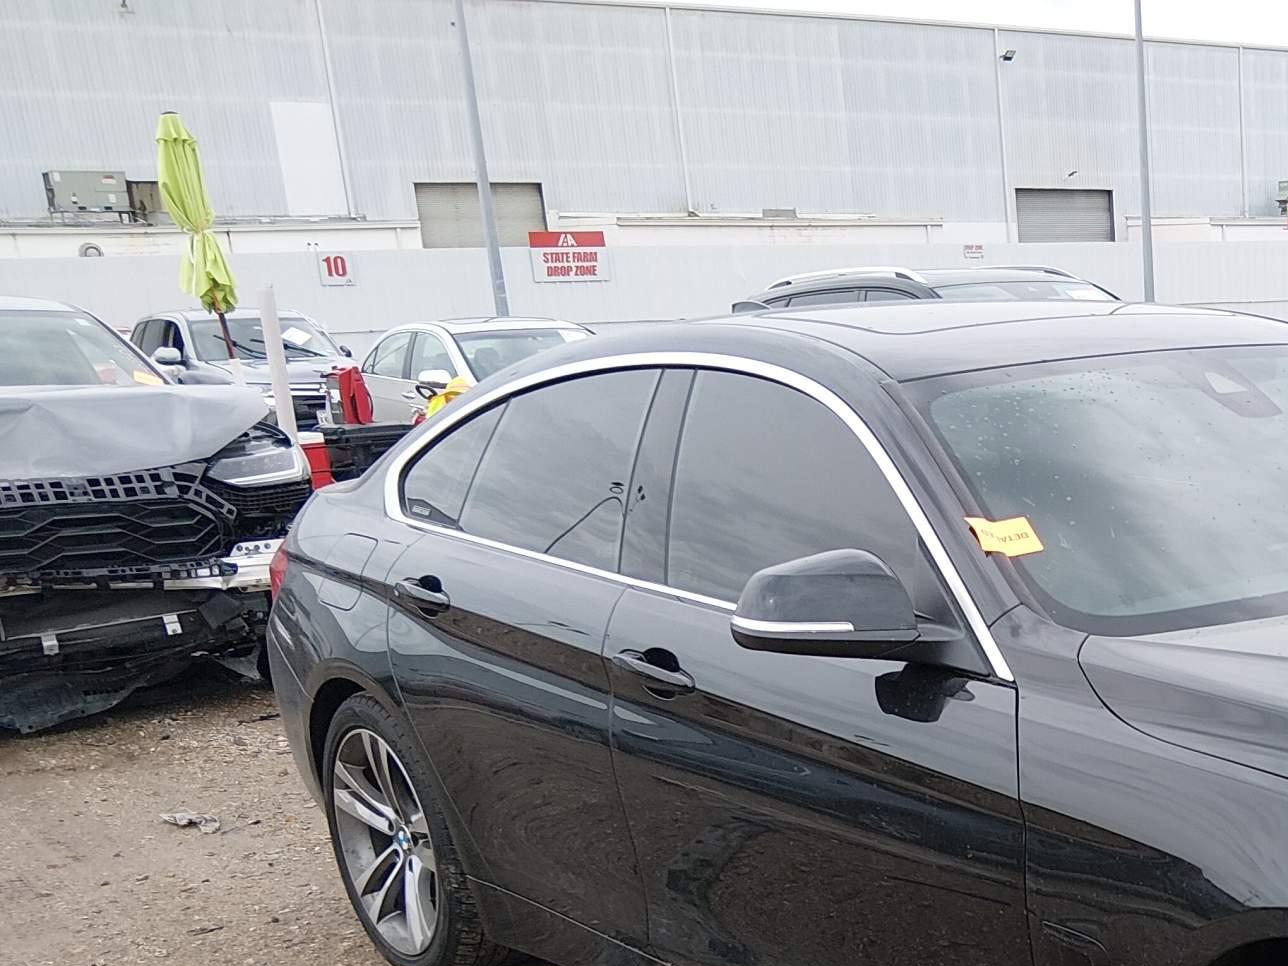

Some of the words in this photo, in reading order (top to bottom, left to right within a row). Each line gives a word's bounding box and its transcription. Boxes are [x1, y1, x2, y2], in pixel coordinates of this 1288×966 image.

[543, 252, 570, 263] STATE
[573, 252, 598, 263] FARM
[322, 256, 347, 277] 10
[547, 266, 573, 277] DROP
[574, 265, 598, 276] ZONE
